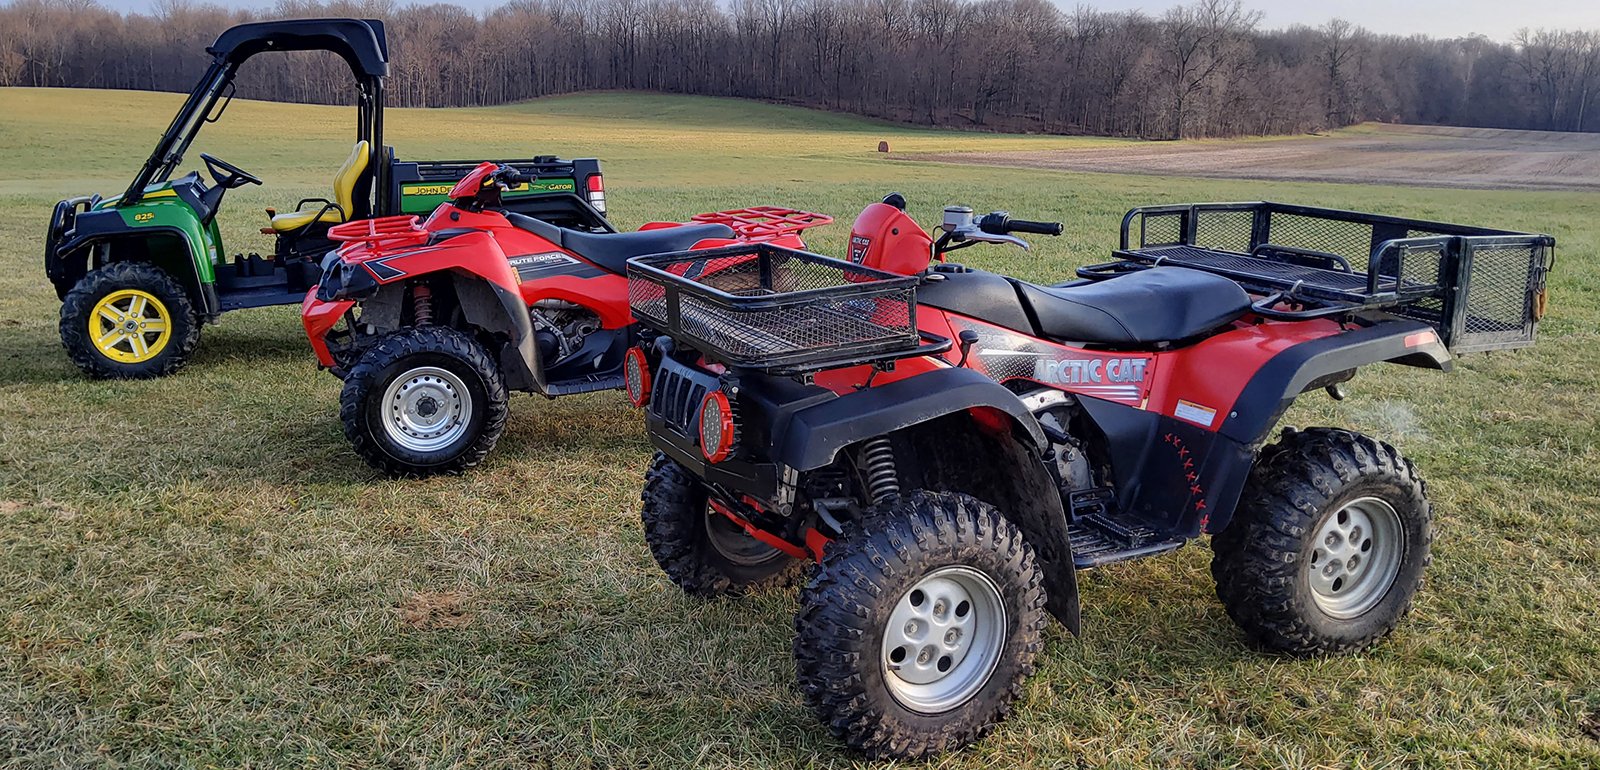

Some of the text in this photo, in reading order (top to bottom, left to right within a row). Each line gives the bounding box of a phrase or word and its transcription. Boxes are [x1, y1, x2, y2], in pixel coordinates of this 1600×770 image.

[415, 187, 438, 195] JOHN
[1033, 358, 1146, 384] ARCTIC CAT
